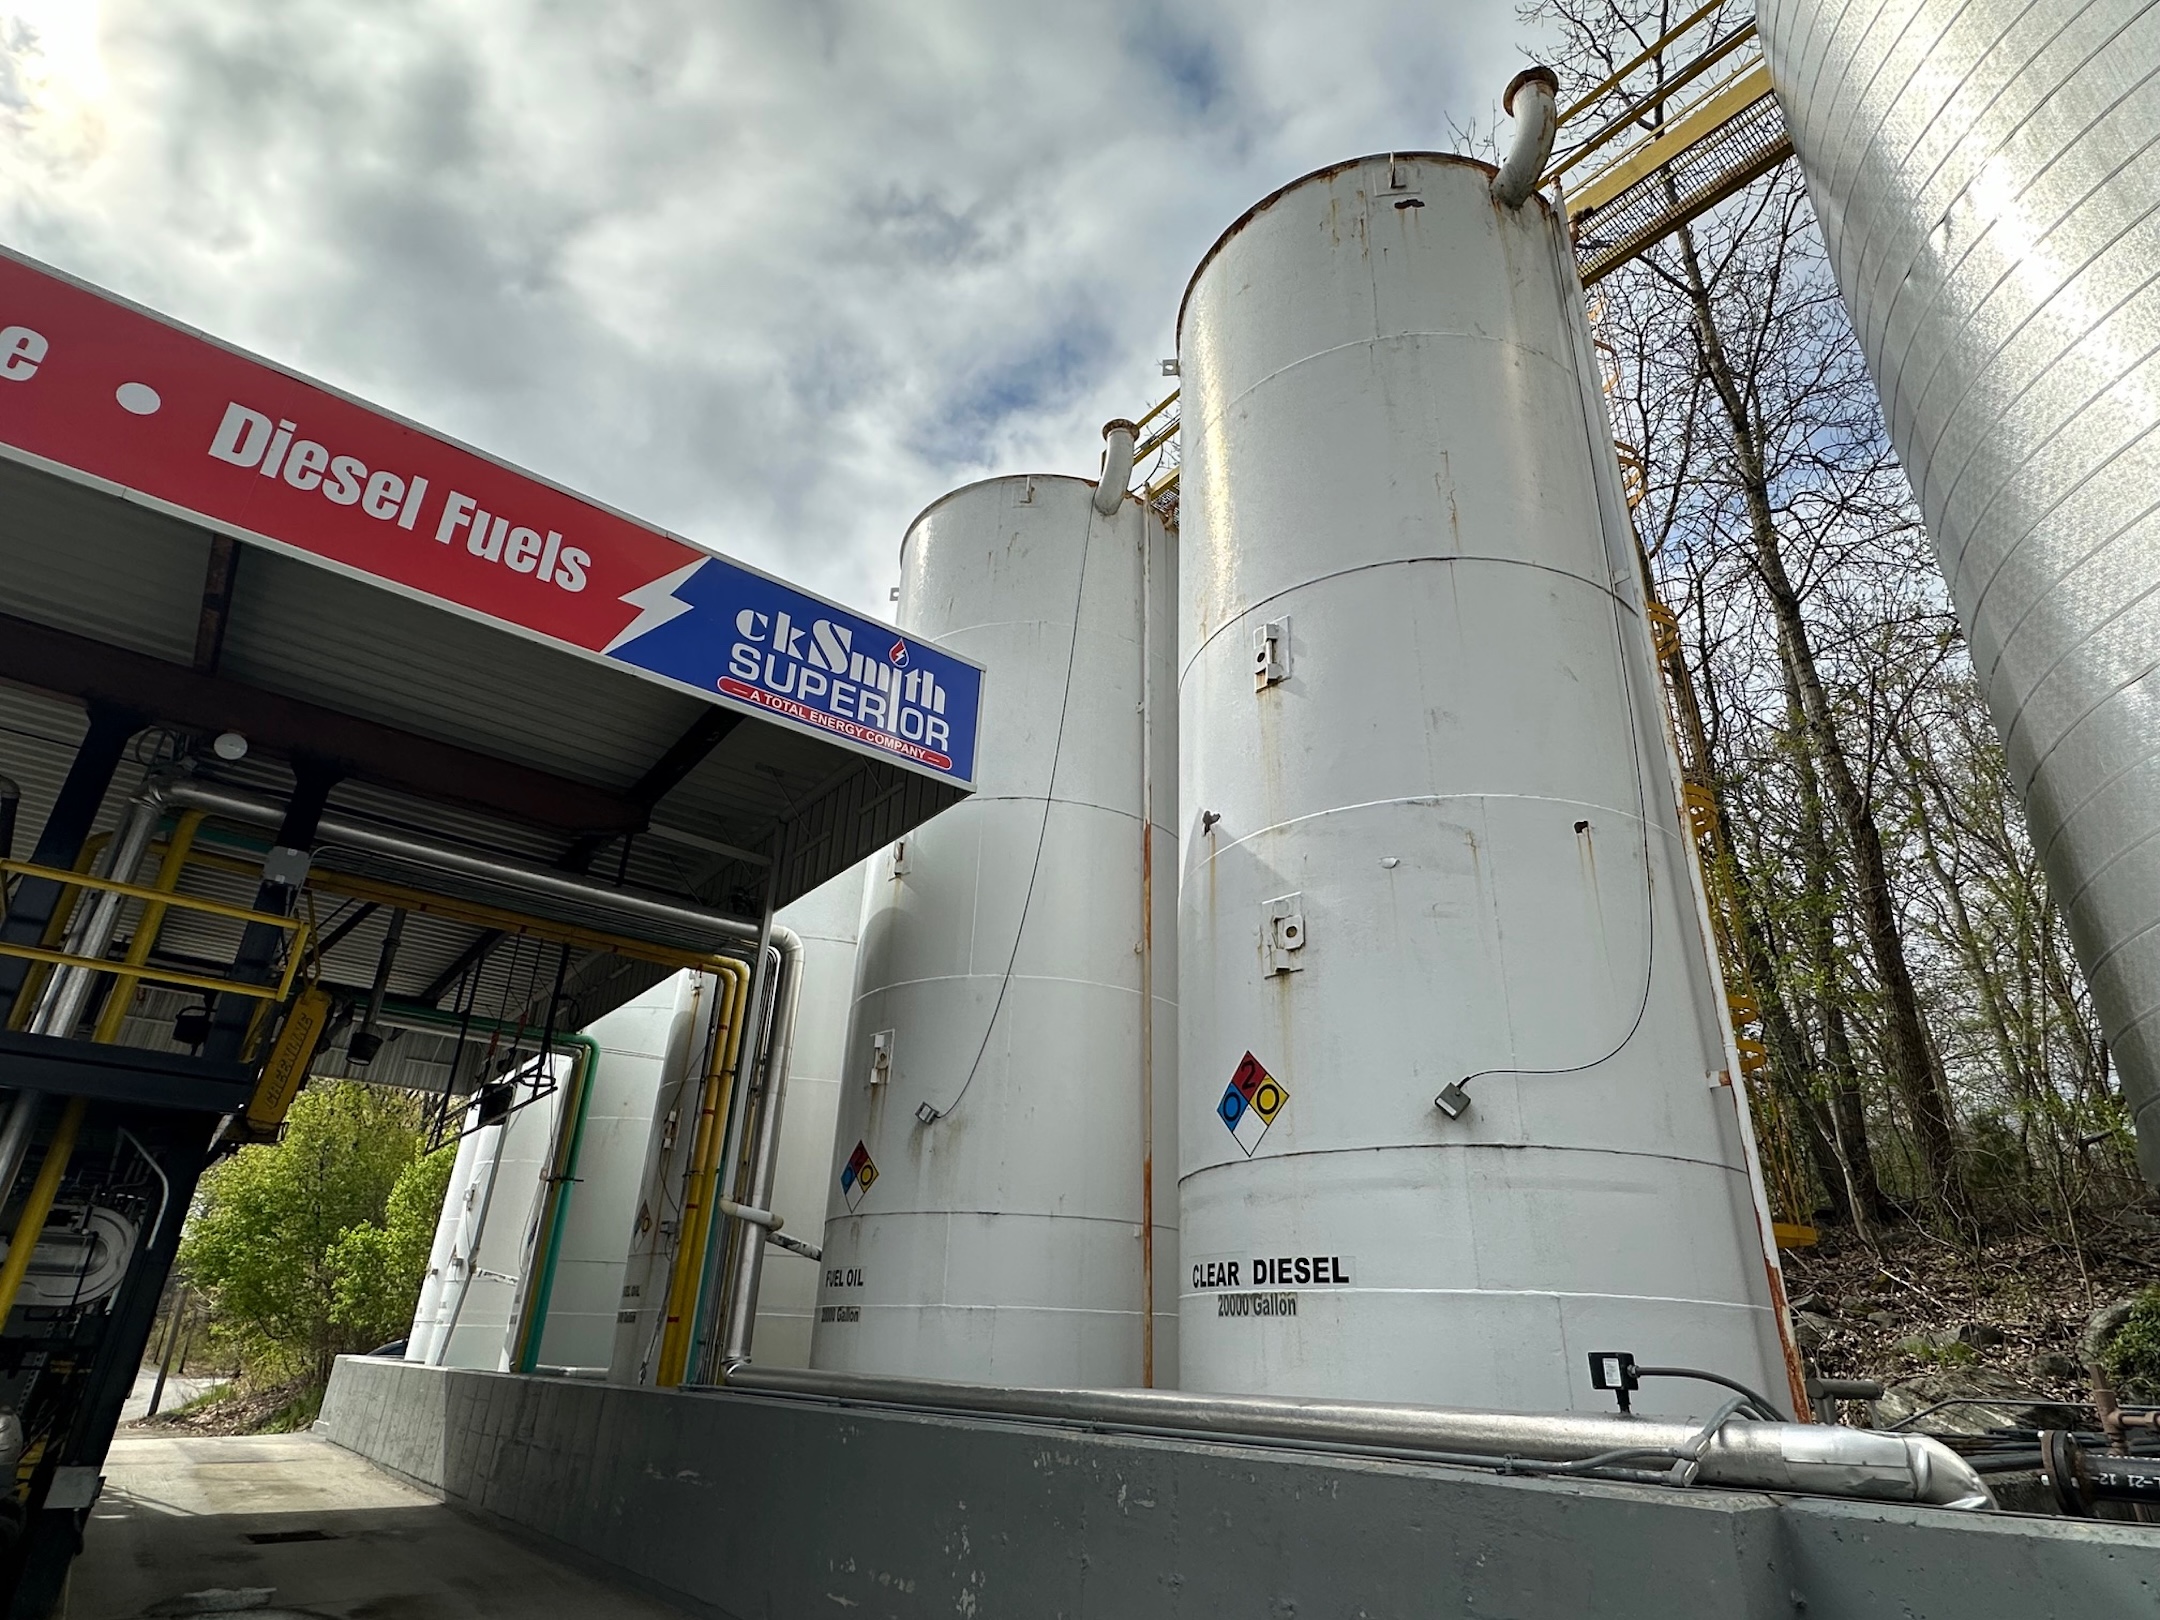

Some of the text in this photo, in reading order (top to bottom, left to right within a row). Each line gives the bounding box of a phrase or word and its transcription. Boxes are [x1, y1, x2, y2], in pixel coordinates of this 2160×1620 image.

[207, 401, 429, 531] Diesel
[434, 488, 592, 593] Fuels
[736, 608, 946, 716] ckSmith
[728, 642, 951, 752] SUPERIOR
[750, 690, 927, 760] A TOTAL ENERGY COMPANY
[1241, 1060, 1256, 1091] 2
[1222, 1083, 1280, 1122] 0 0
[825, 1268, 864, 1287] FUEL OIL
[1193, 1257, 1350, 1288] CLEAR DIESEL
[837, 1307, 859, 1323] Gallon
[1218, 1293, 1297, 1317] 20000 Gallon
